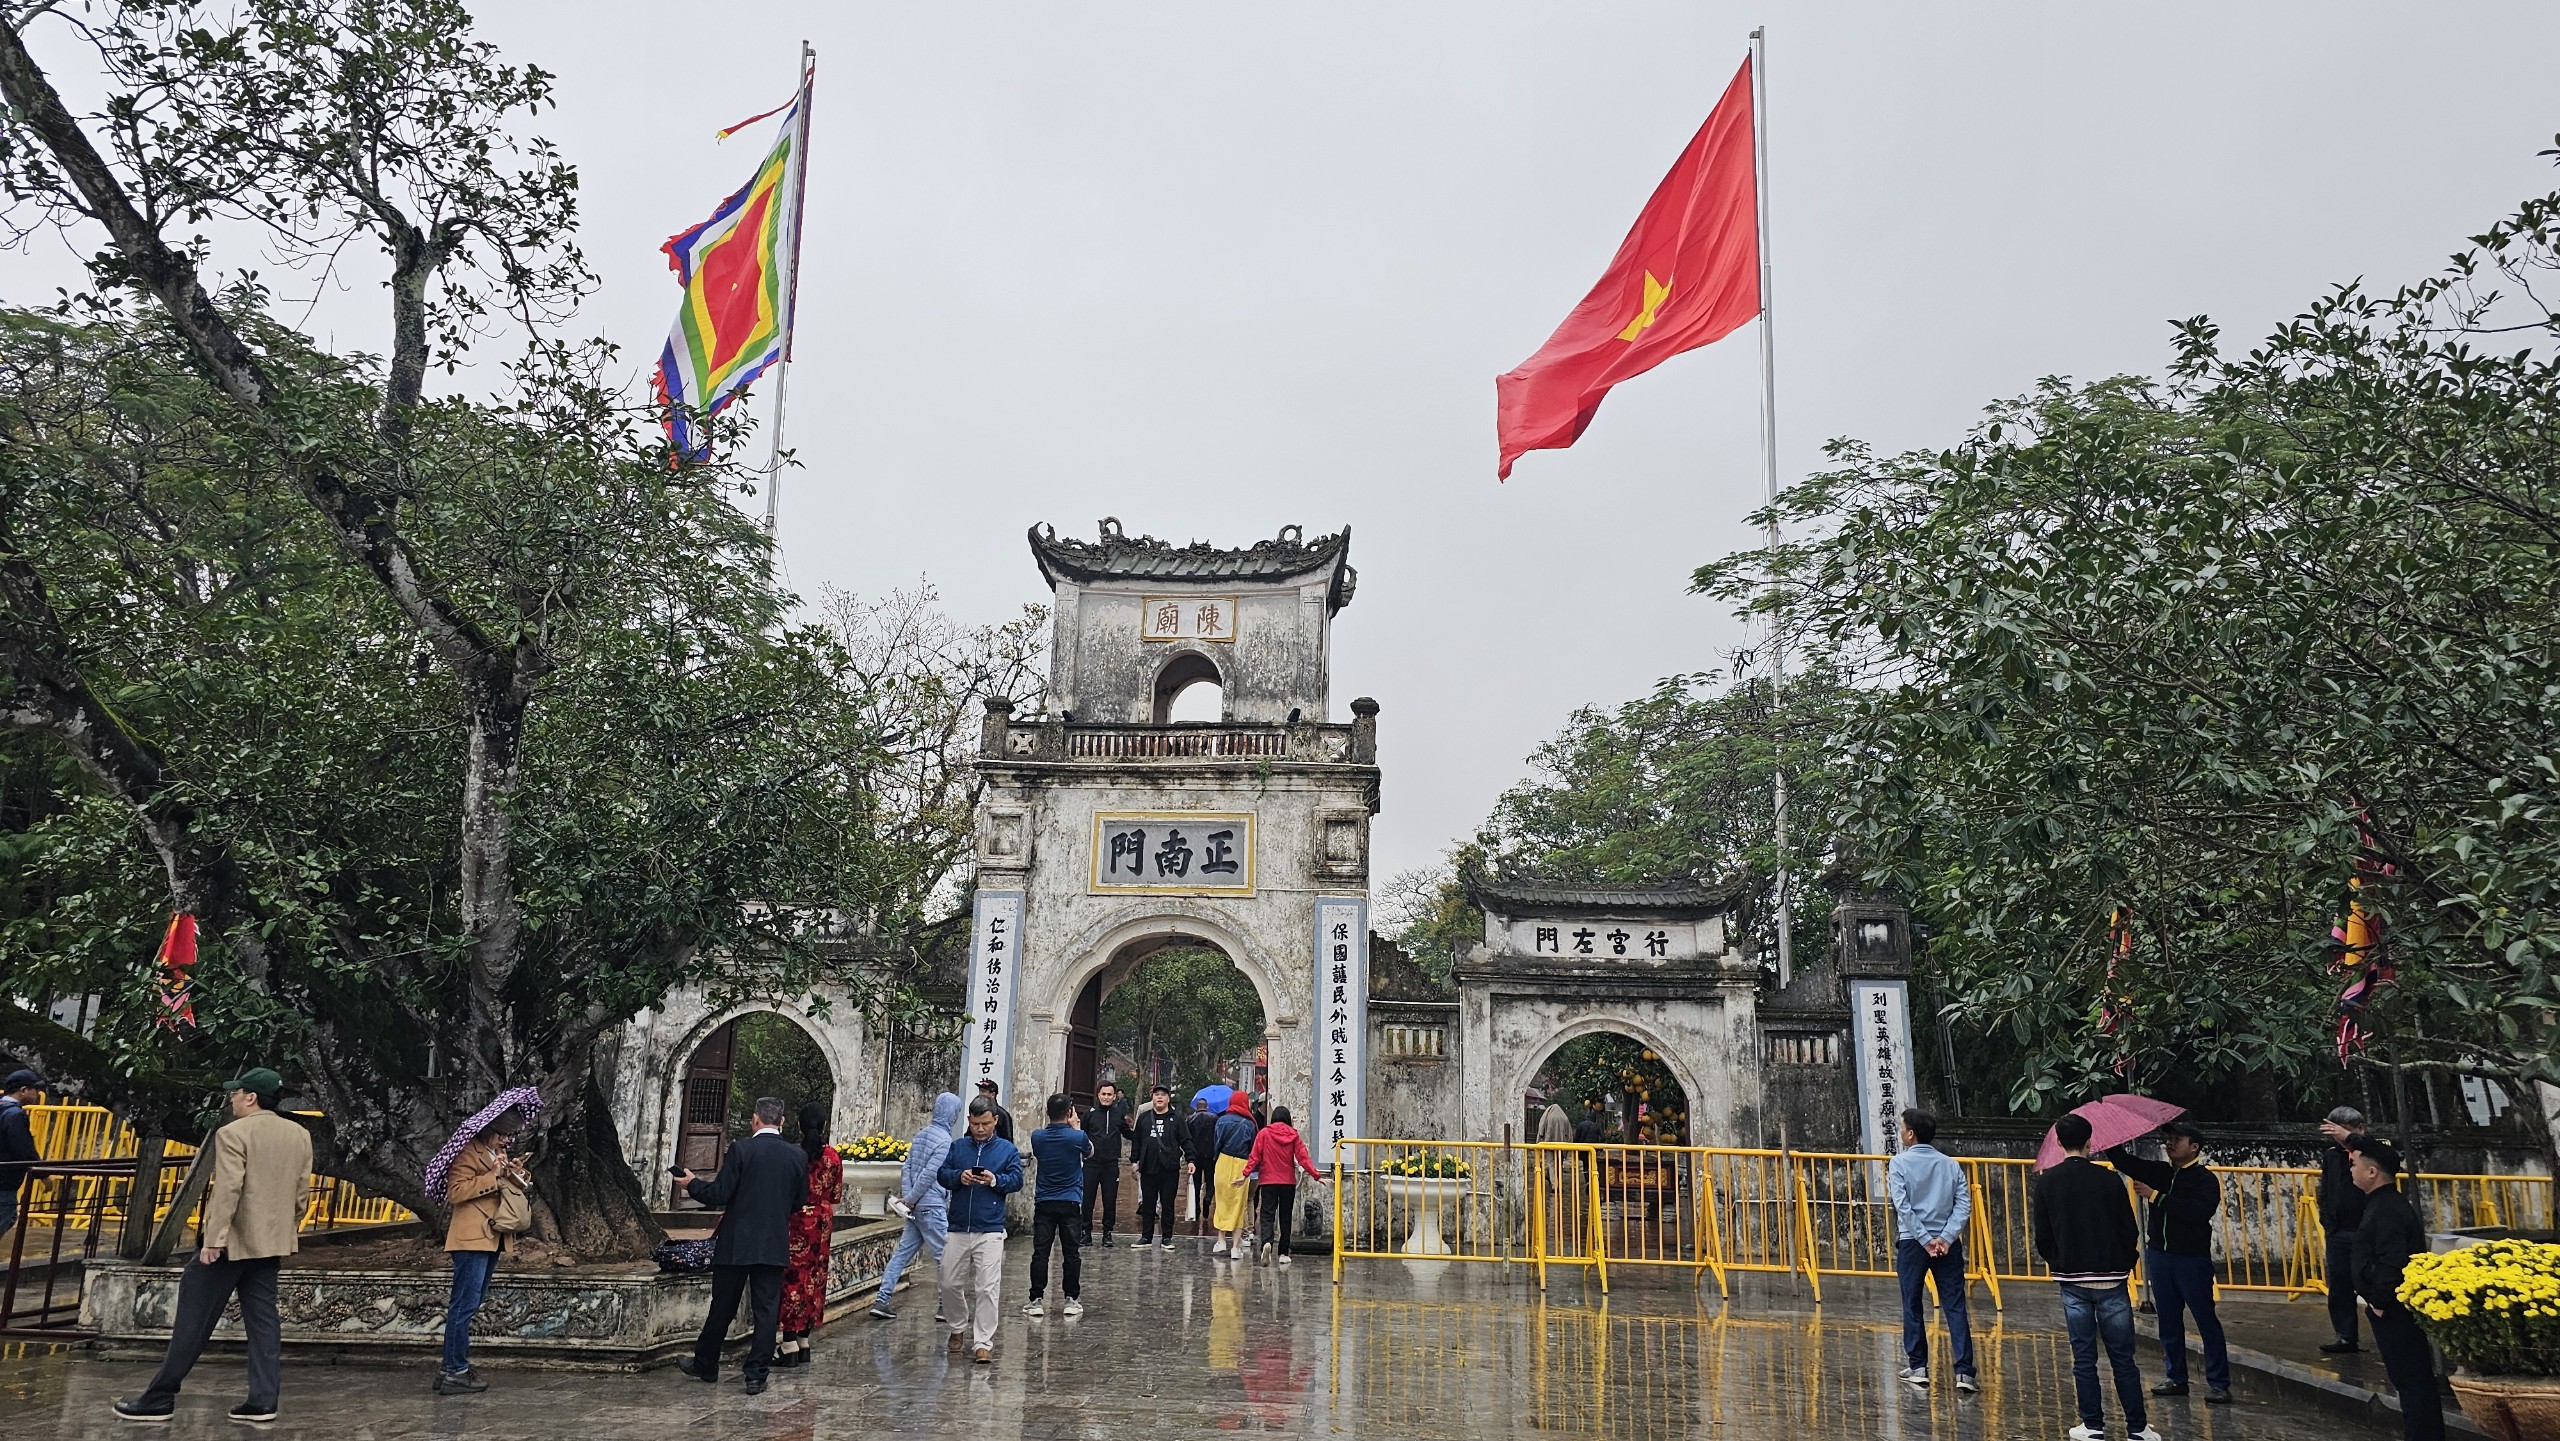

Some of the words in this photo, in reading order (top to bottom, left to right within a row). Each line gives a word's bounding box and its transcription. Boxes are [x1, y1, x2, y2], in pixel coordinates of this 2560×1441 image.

[1155, 602, 1223, 636] 陳廟
[1110, 828, 1239, 878] 正南門
[1536, 926, 1670, 957] 行宮左門
